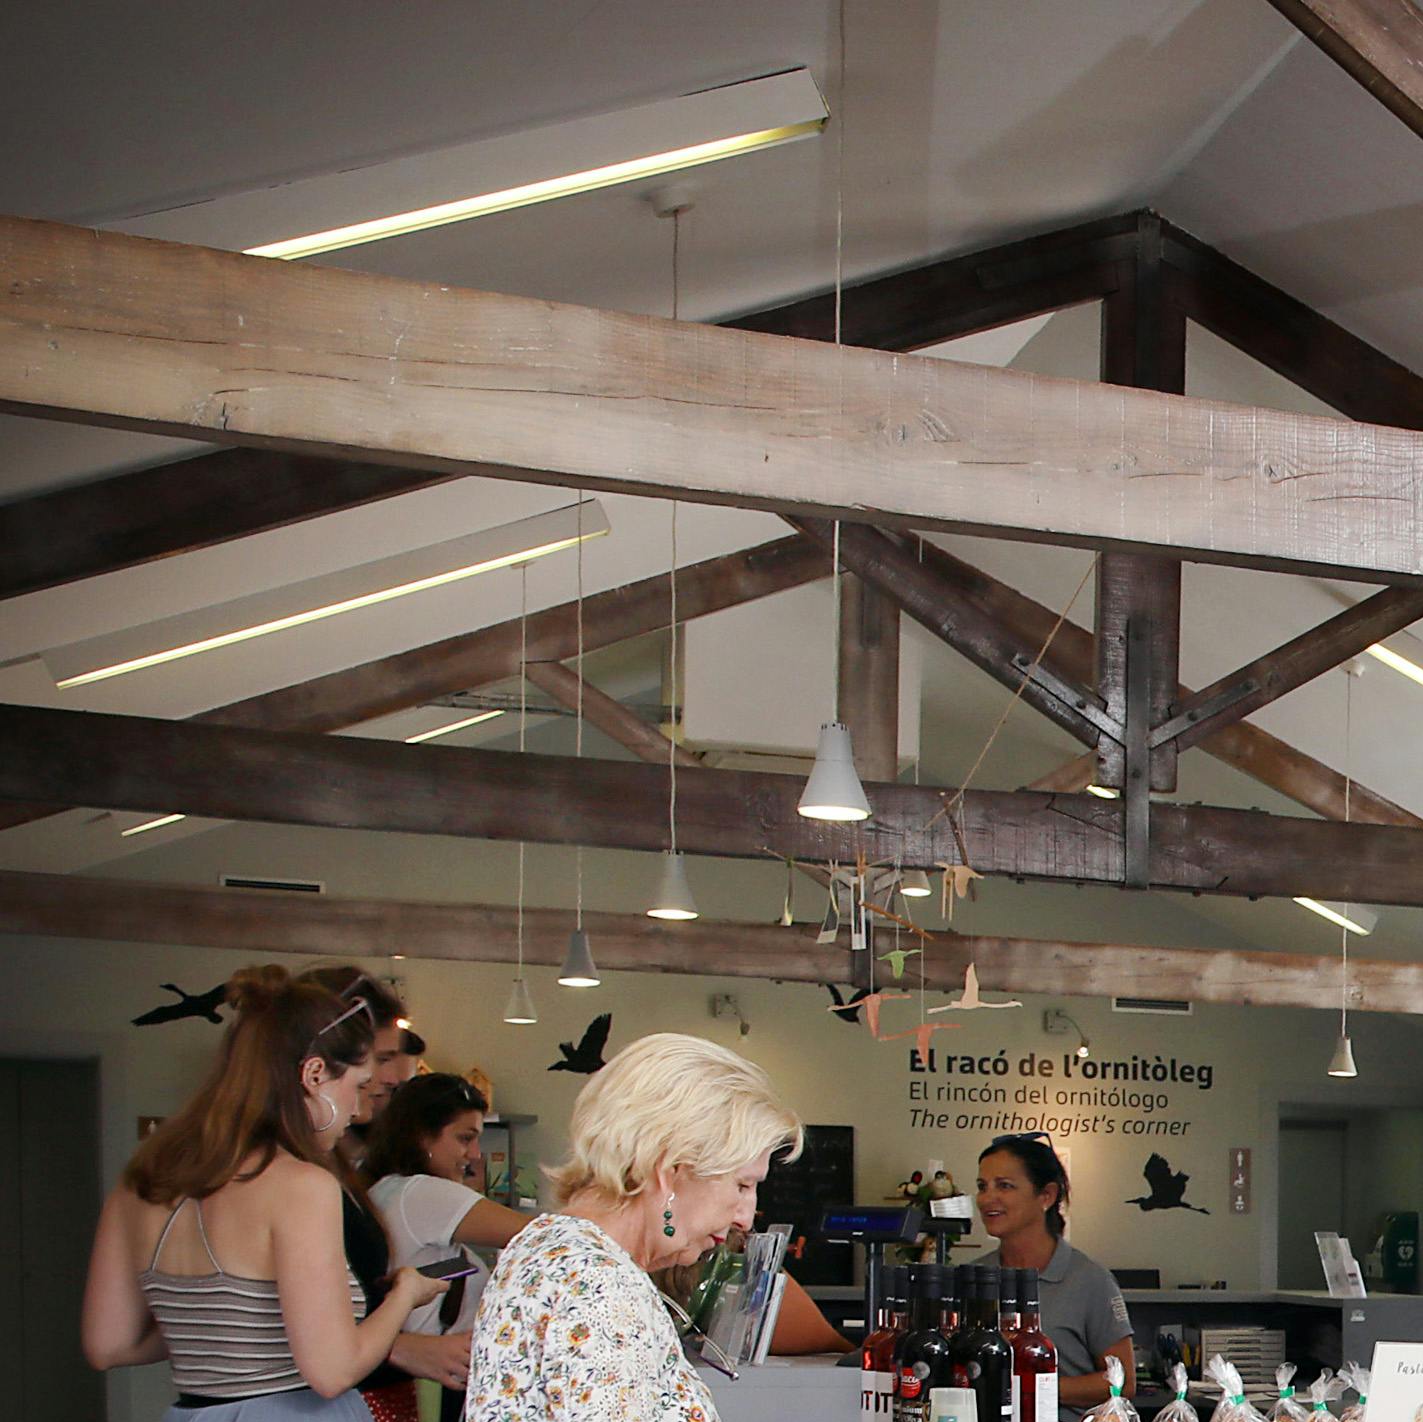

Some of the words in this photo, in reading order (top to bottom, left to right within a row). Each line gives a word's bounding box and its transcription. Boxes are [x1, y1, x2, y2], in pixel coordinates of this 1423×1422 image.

[909, 1049, 936, 1073] El
[947, 1049, 1009, 1076] racó
[1019, 1053, 1054, 1078] de
[1064, 1055, 1213, 1090] l'ornitòleg
[909, 1082, 928, 1101] El
[936, 1082, 1006, 1105] rincón
[1014, 1084, 1048, 1105] del
[1055, 1086, 1169, 1111] ornitólogo
[909, 1109, 947, 1130] The
[954, 1110, 1115, 1137] ornithologist's
[1122, 1118, 1191, 1136] corner
